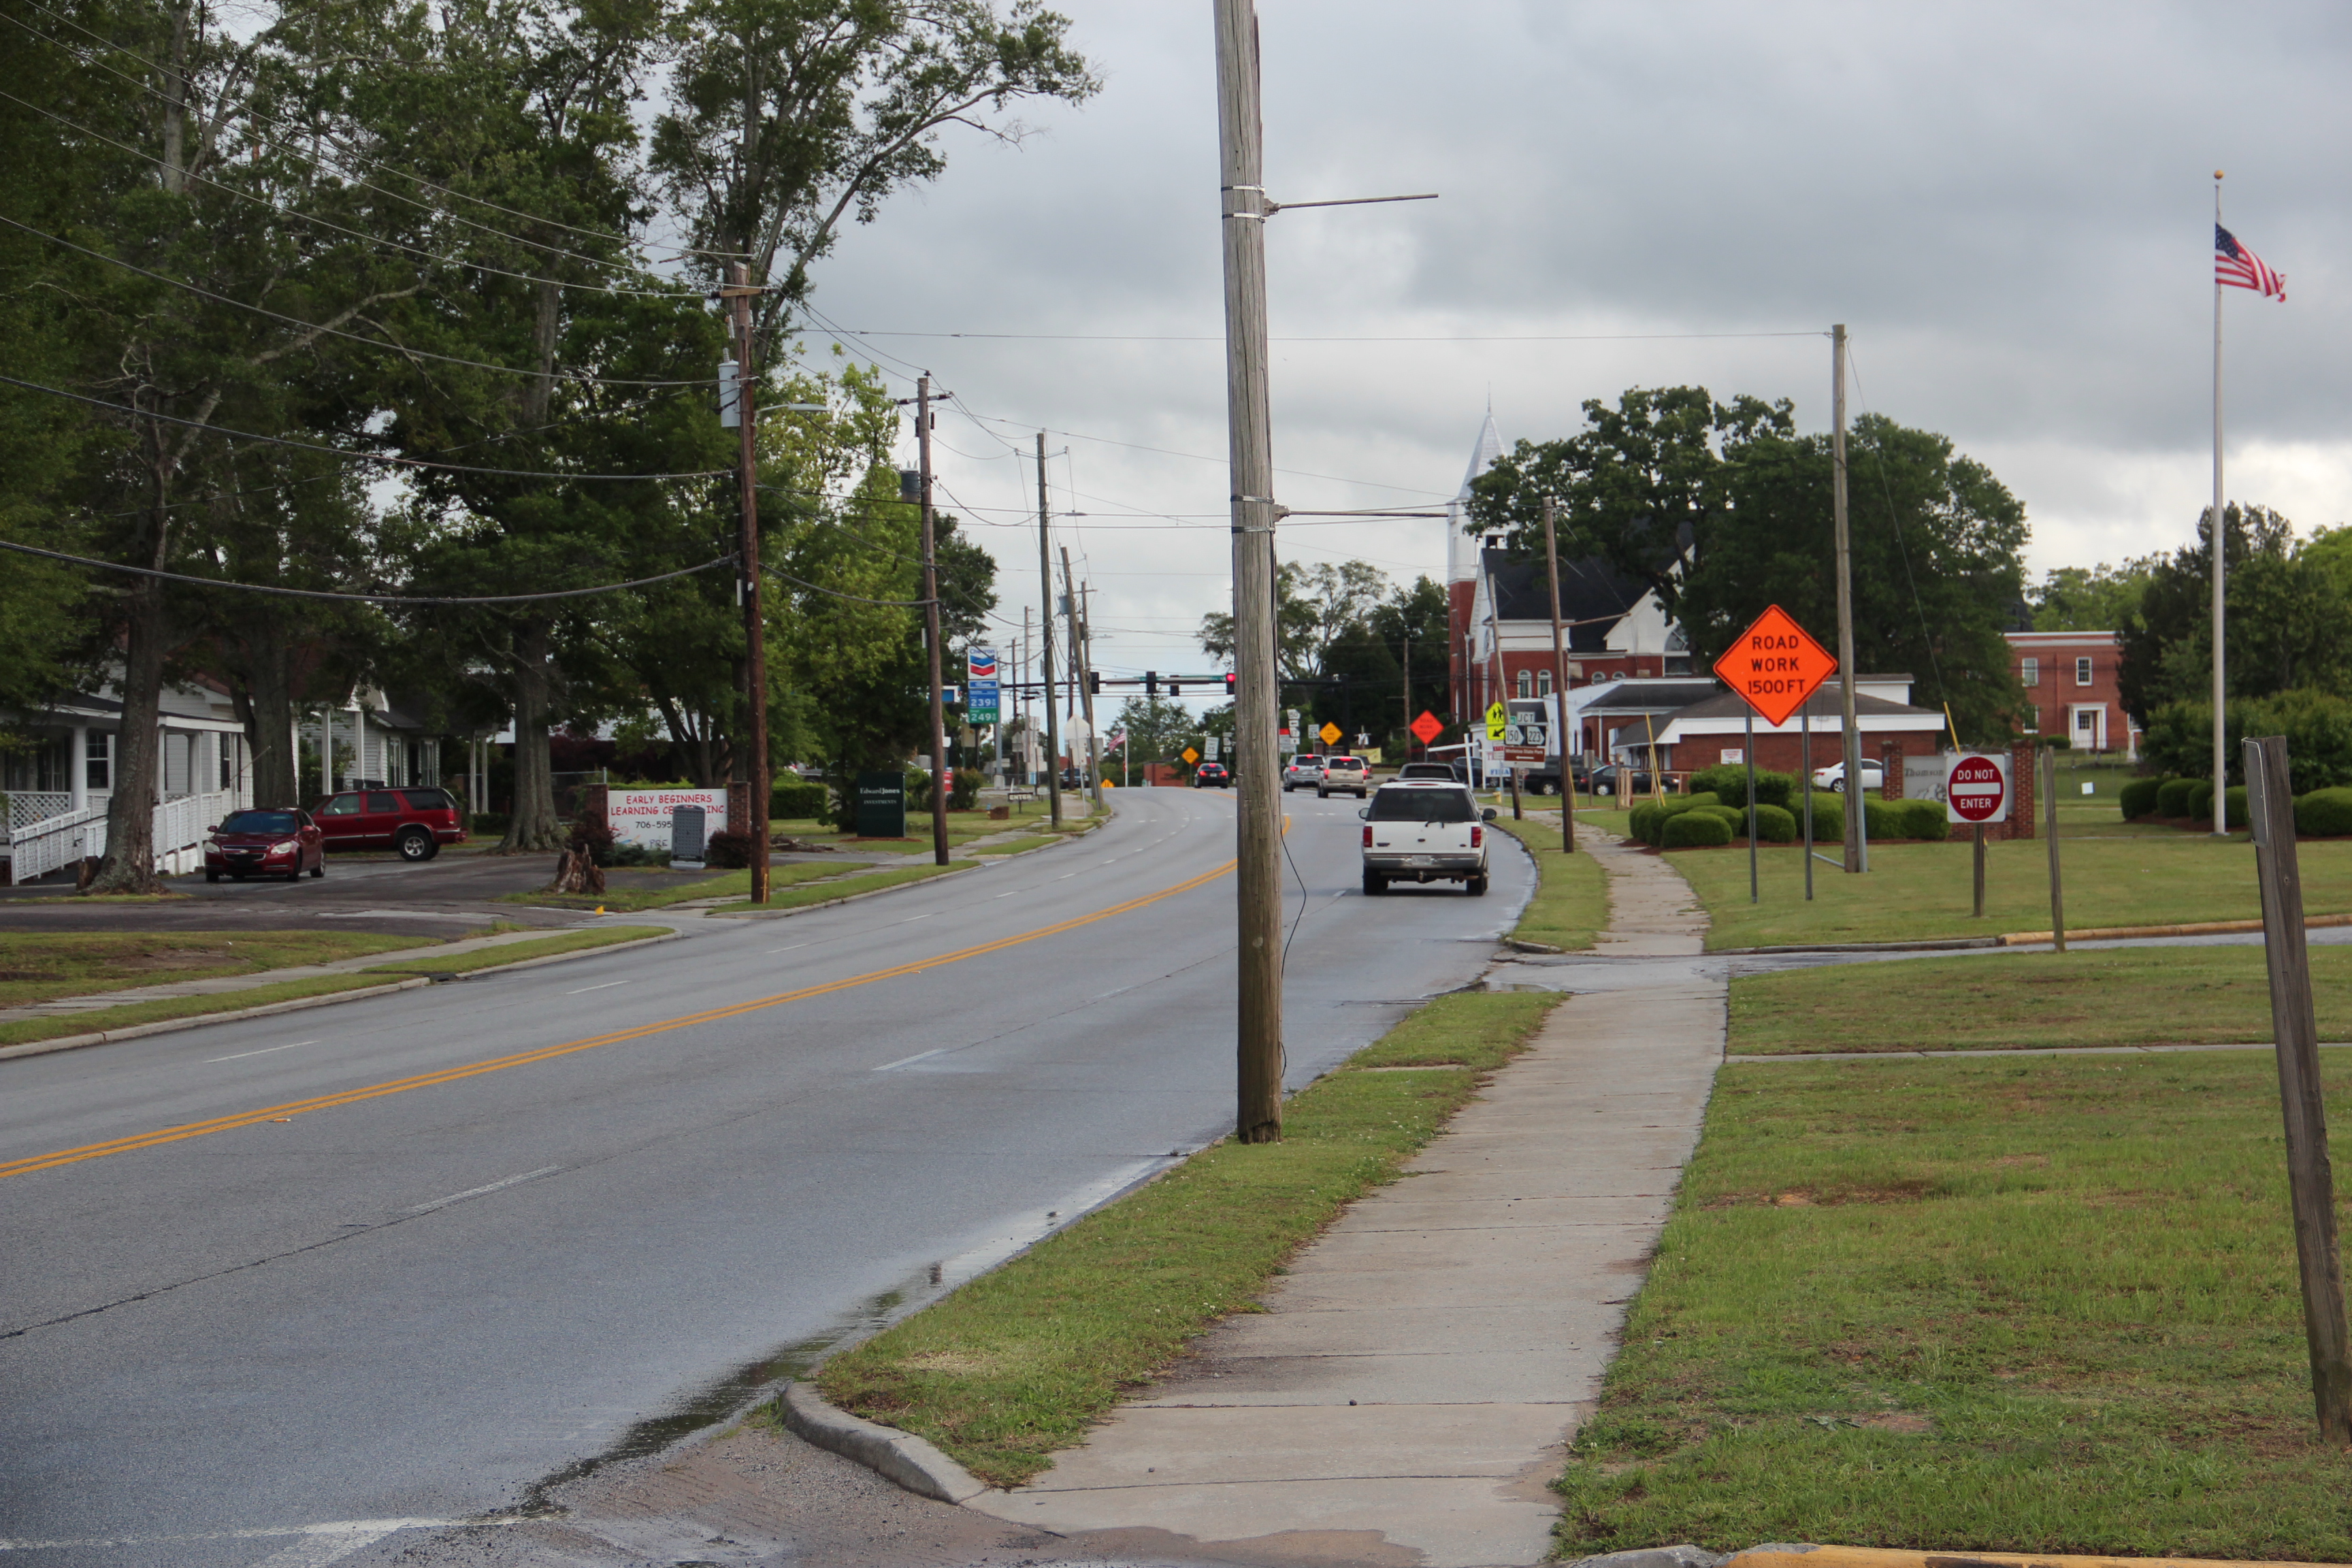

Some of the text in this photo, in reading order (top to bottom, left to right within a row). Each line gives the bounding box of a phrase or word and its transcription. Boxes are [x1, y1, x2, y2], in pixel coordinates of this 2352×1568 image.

[1752, 636, 1799, 650] ROAD
[1751, 657, 1799, 672] WORK
[1518, 714, 1533, 722] JCT
[1507, 730, 1519, 741] 150
[1529, 731, 1541, 742] 223
[1904, 768, 1944, 777] Thomson
[1957, 770, 1972, 780] DO
[1974, 769, 1994, 779] NOT
[626, 794, 713, 804] EARLY BEGINNERS
[1960, 798, 1991, 808] ENTER
[610, 806, 659, 815] LEARNING
[706, 805, 727, 814] INC.
[635, 821, 672, 829] 706-595
[649, 839, 668, 847] PRE
